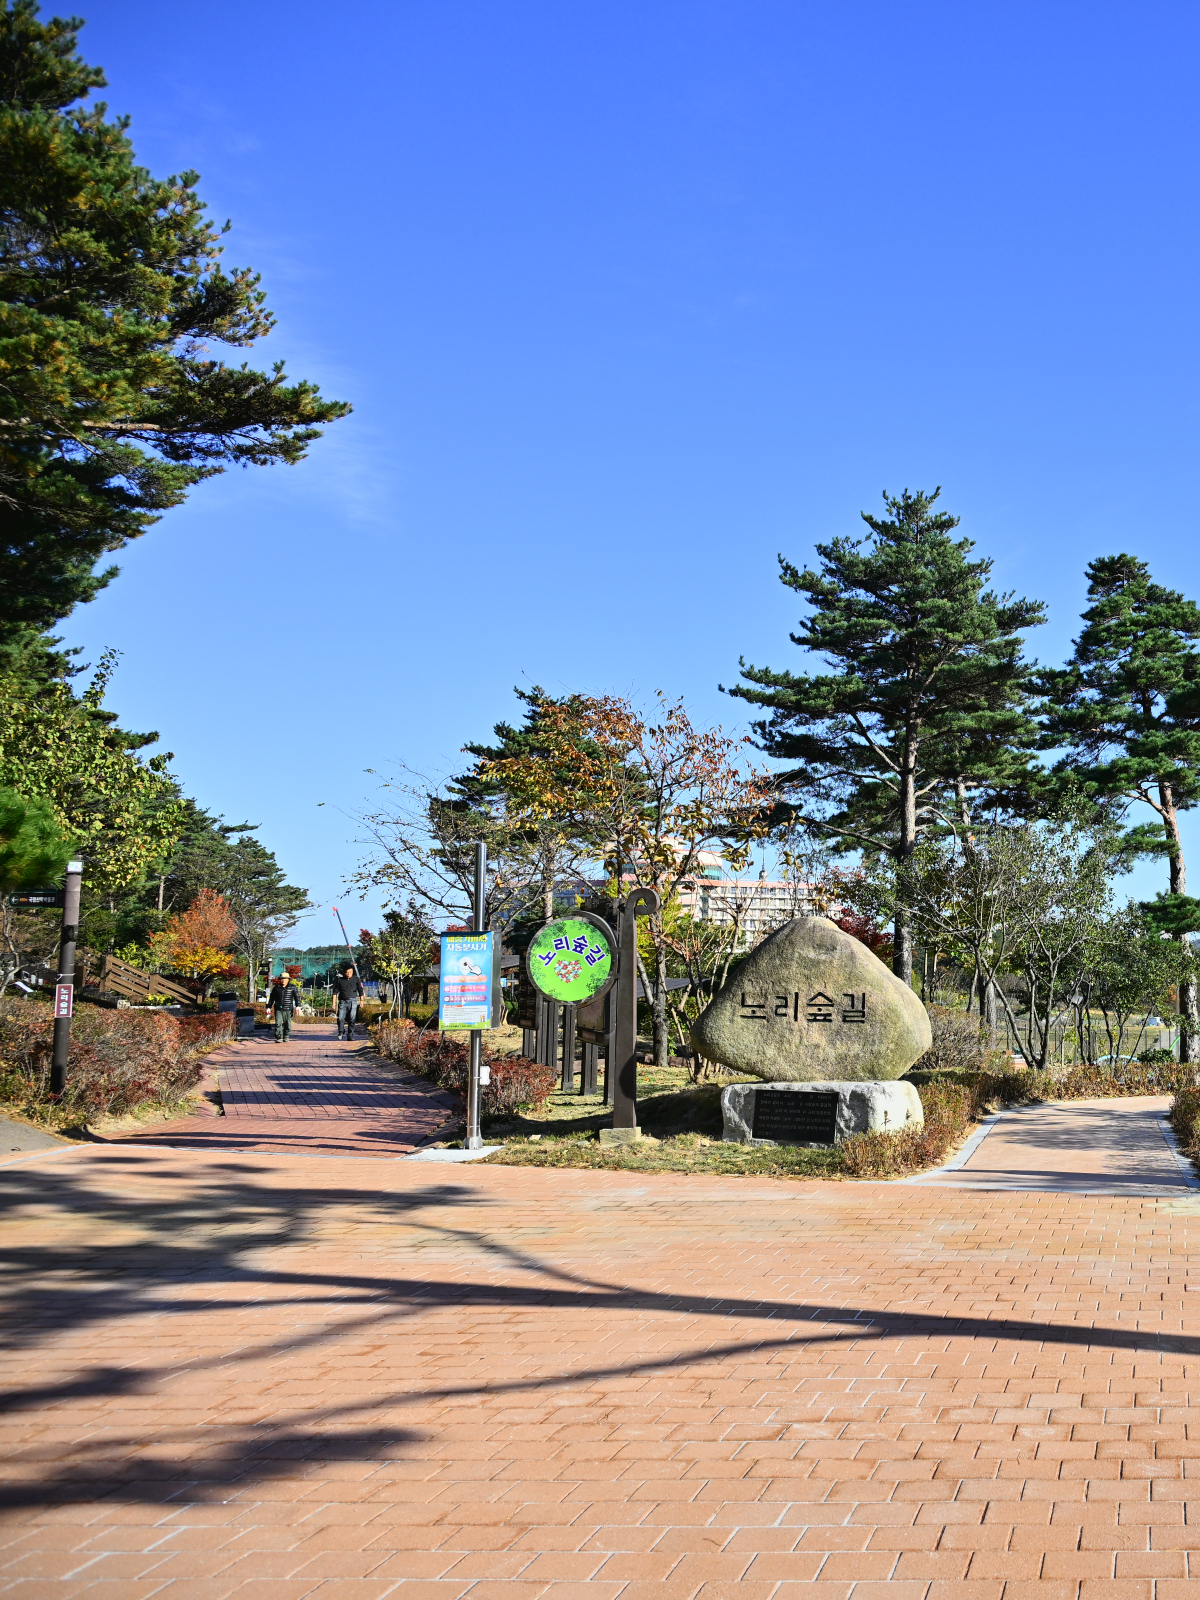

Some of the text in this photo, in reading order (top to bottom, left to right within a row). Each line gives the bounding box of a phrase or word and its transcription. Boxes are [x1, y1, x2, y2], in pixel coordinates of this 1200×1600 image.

[446, 943, 487, 952] 자동분사기
[538, 934, 606, 967] 노리숲길
[59, 987, 69, 1015] 노리숲길
[740, 992, 866, 1024] 노리숲길
